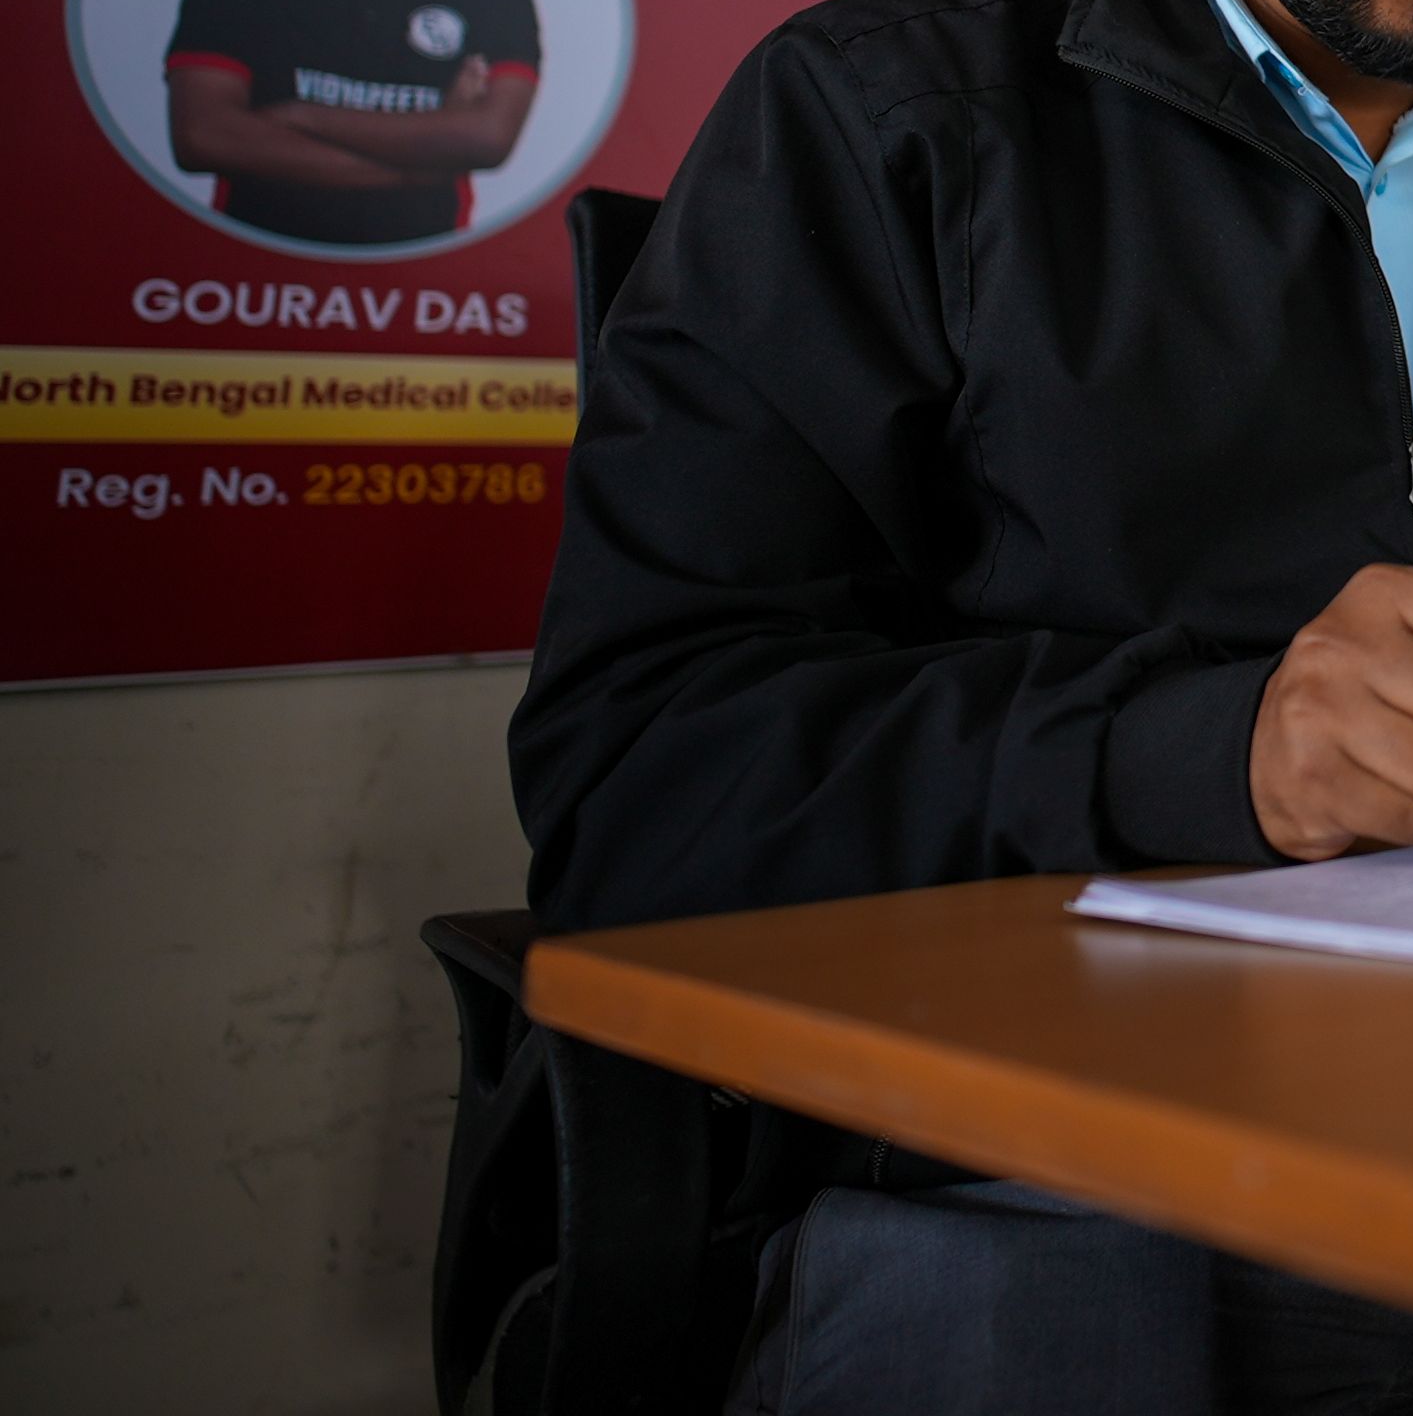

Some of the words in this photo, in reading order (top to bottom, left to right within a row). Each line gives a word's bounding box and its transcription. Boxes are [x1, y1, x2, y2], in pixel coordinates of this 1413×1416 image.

[131, 277, 403, 332] GOURAV
[414, 289, 528, 337] DAS
[129, 373, 291, 418] Bengal
[302, 378, 468, 412] Medical
[56, 467, 184, 521] Reg.
[200, 467, 290, 507] No.
[303, 462, 547, 505] 22303786
